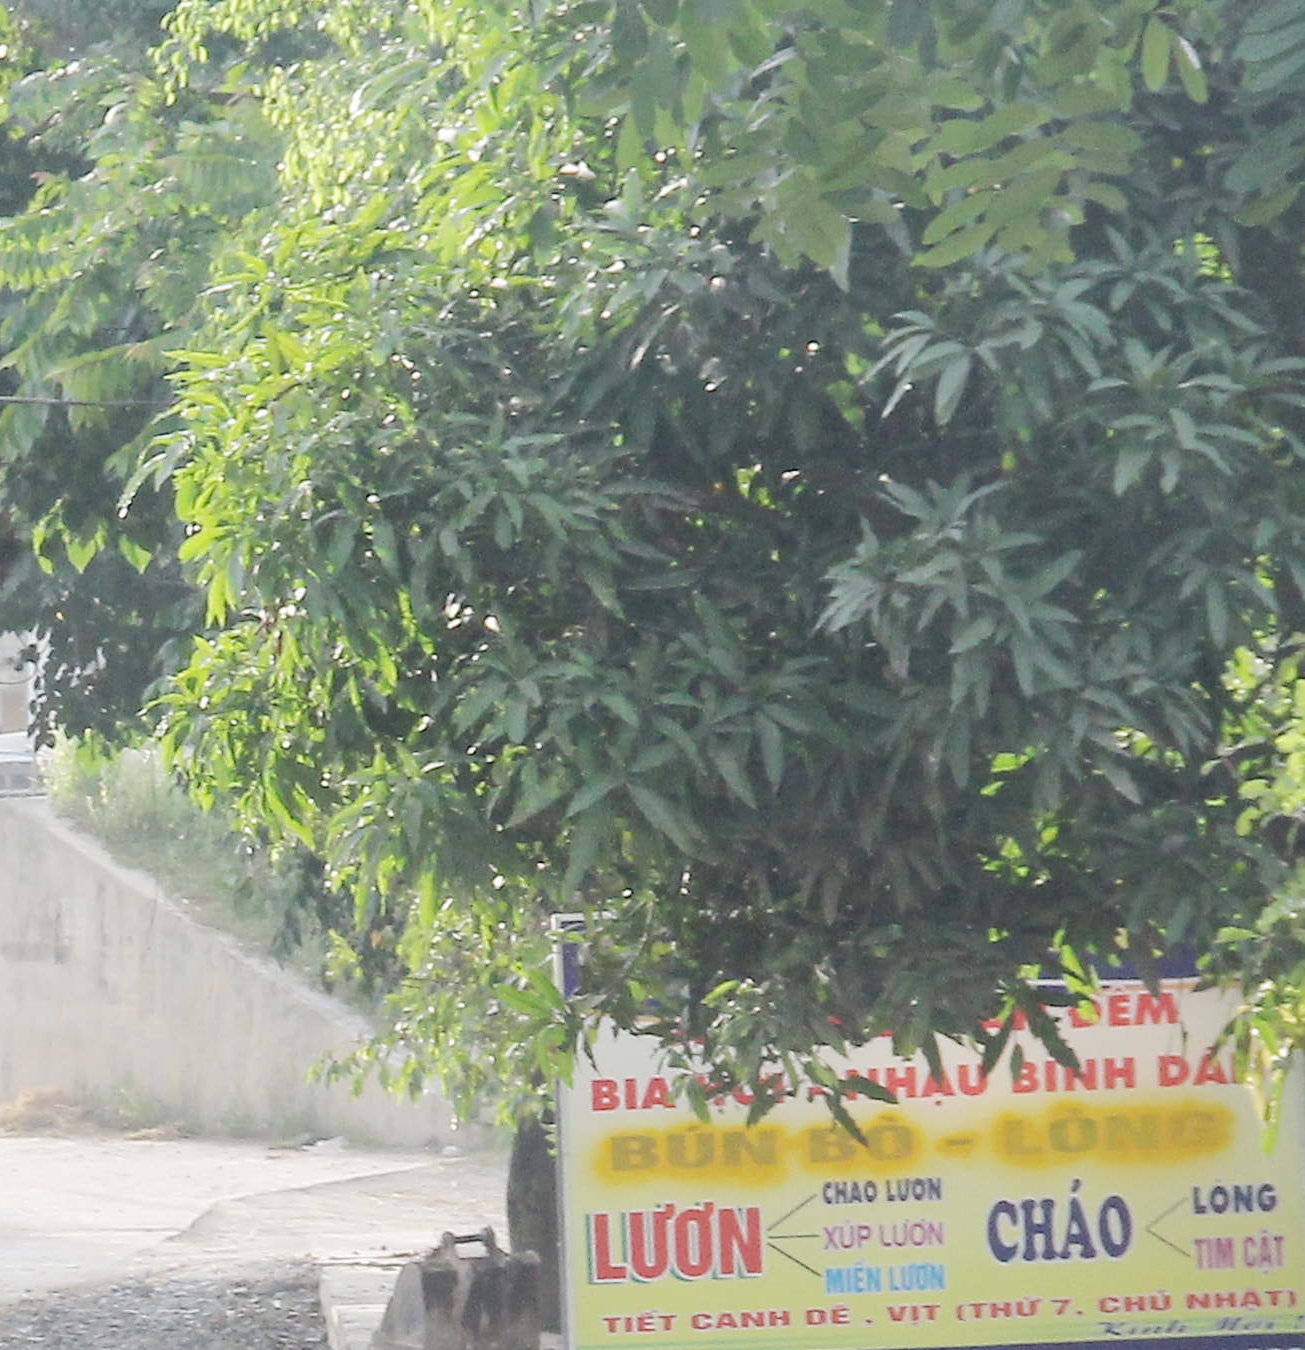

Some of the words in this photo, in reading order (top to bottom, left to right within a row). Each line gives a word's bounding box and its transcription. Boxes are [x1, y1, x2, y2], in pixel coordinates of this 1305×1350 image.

[591, 1077, 676, 1111] BIA
[610, 1125, 778, 1172] BÚN
[823, 1219, 872, 1250] XÚP
[988, 1178, 1133, 1263] CHÁO
[590, 1202, 764, 1281] LƯƠN
[1194, 1237, 1235, 1269] TIM
[602, 1309, 677, 1333] TIẾT
[691, 1310, 791, 1330] CANH
[886, 1304, 942, 1326] VỊT
